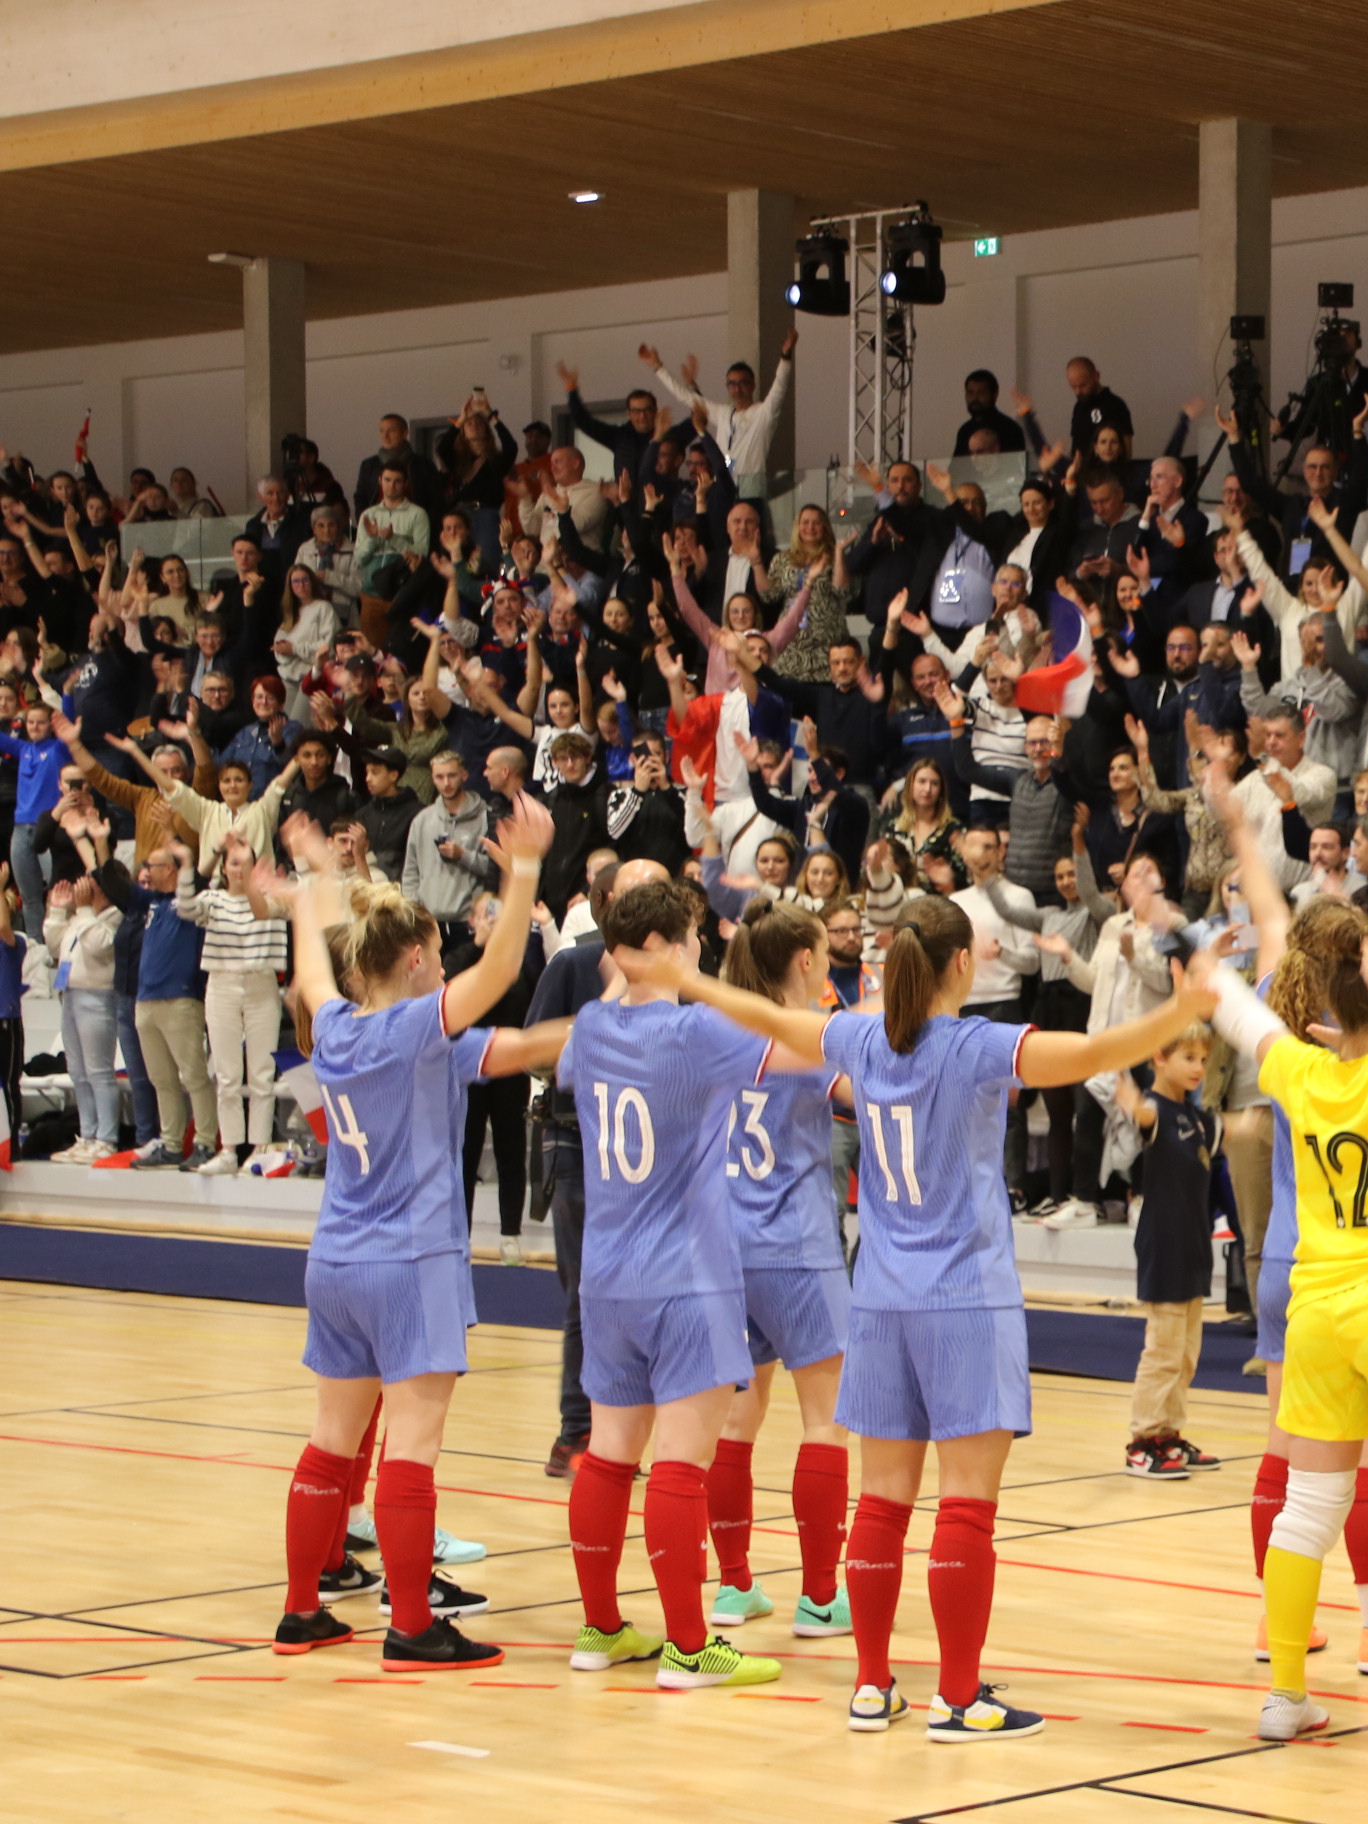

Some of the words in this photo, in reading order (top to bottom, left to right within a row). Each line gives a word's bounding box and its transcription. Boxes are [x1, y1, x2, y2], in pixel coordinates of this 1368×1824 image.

[321, 1084, 369, 1175] 4
[594, 1082, 655, 1184] 10
[866, 1102, 922, 1206] 11
